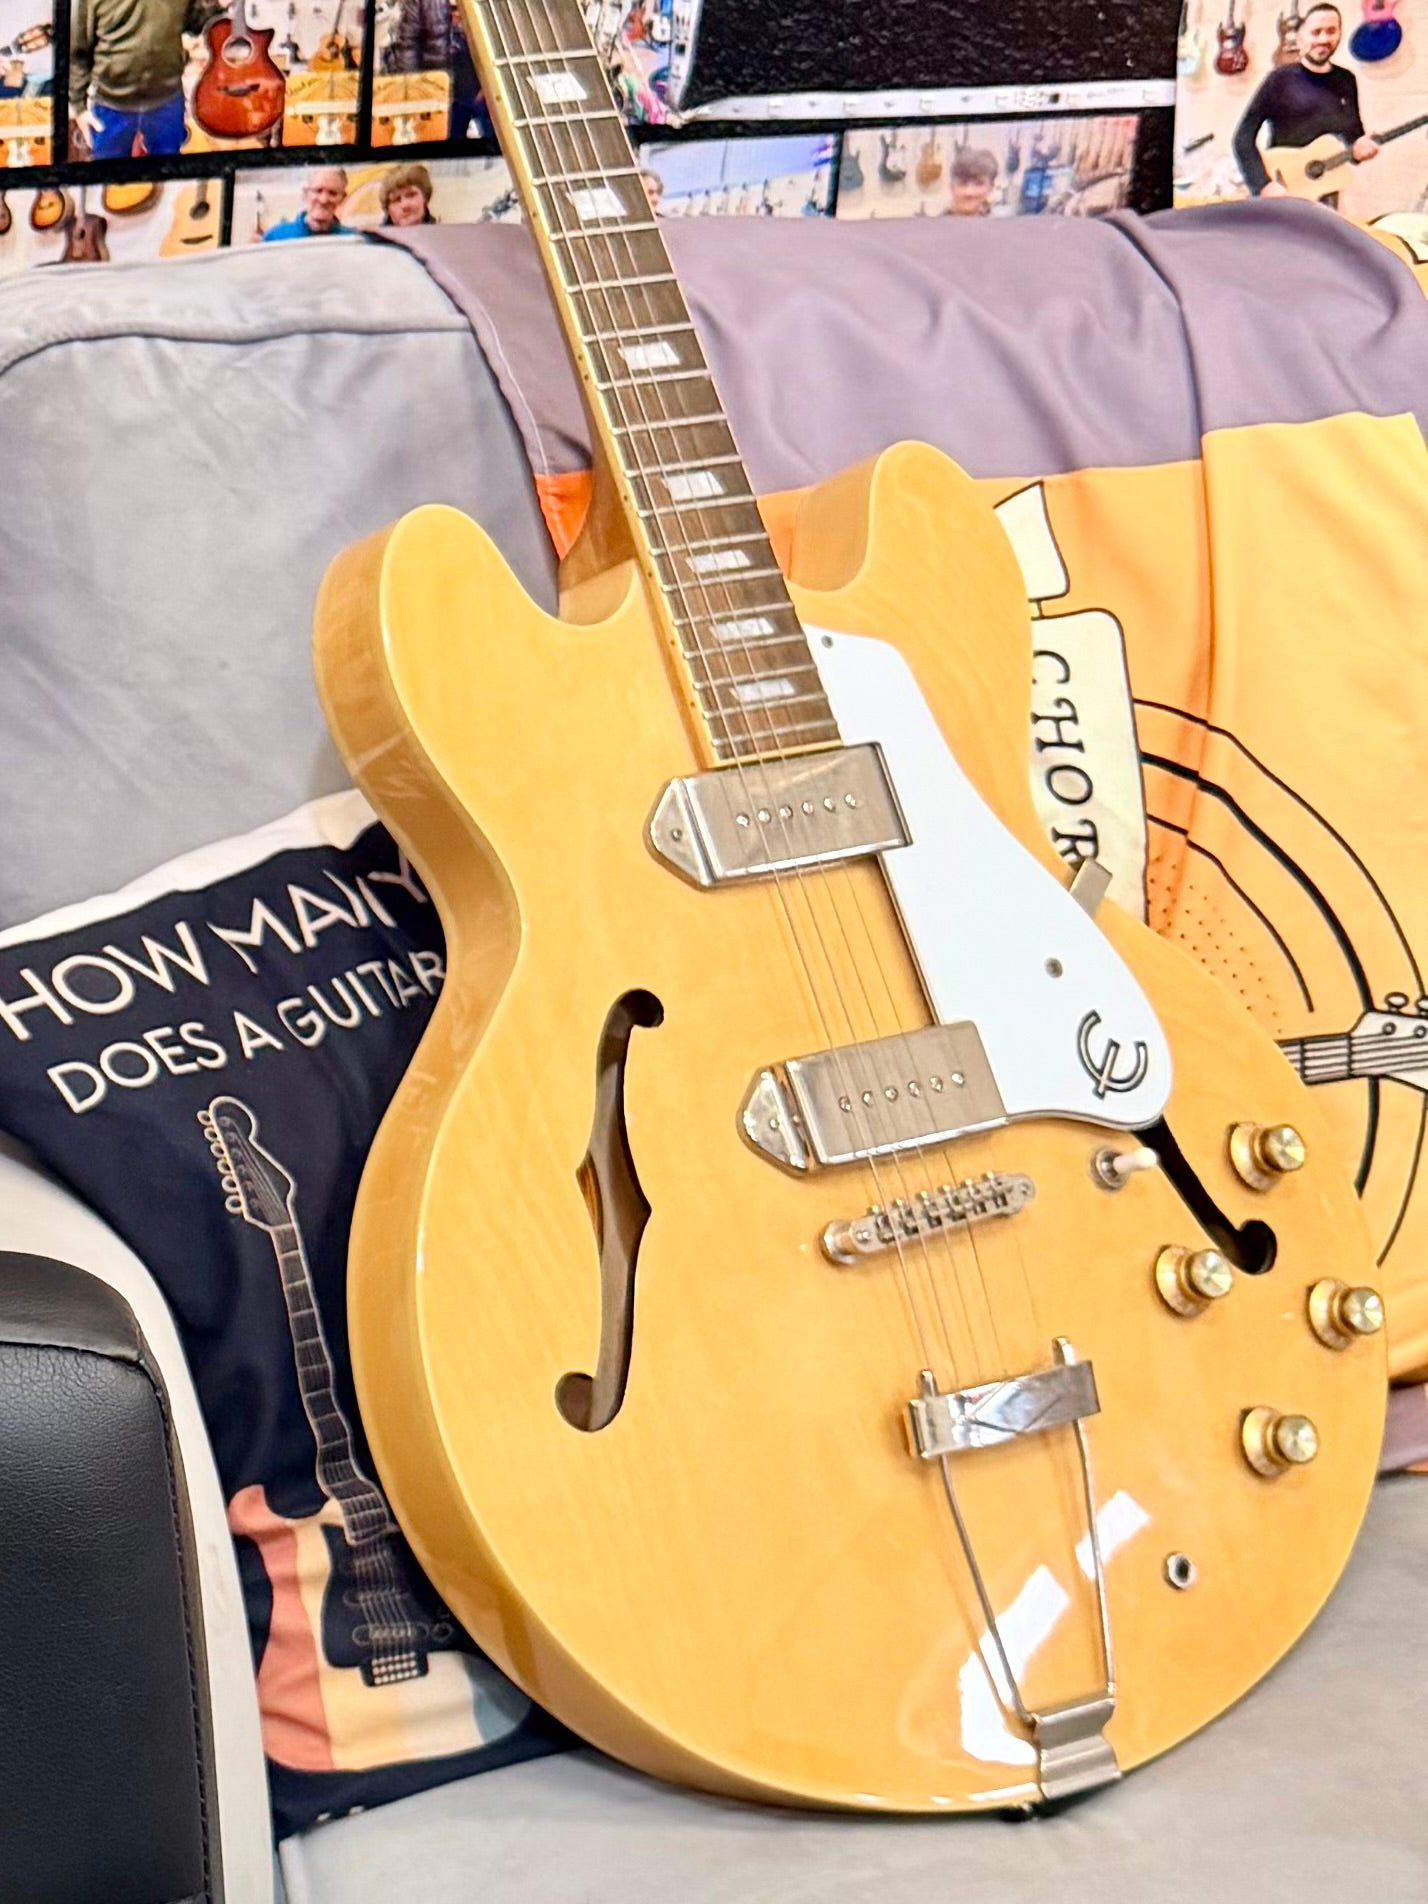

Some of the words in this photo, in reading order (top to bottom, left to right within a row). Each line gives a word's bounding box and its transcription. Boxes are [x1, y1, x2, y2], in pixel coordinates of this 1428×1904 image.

[47, 1021, 228, 1115] DOES
[234, 1010, 285, 1061] A
[276, 949, 447, 1048] GUITAR
